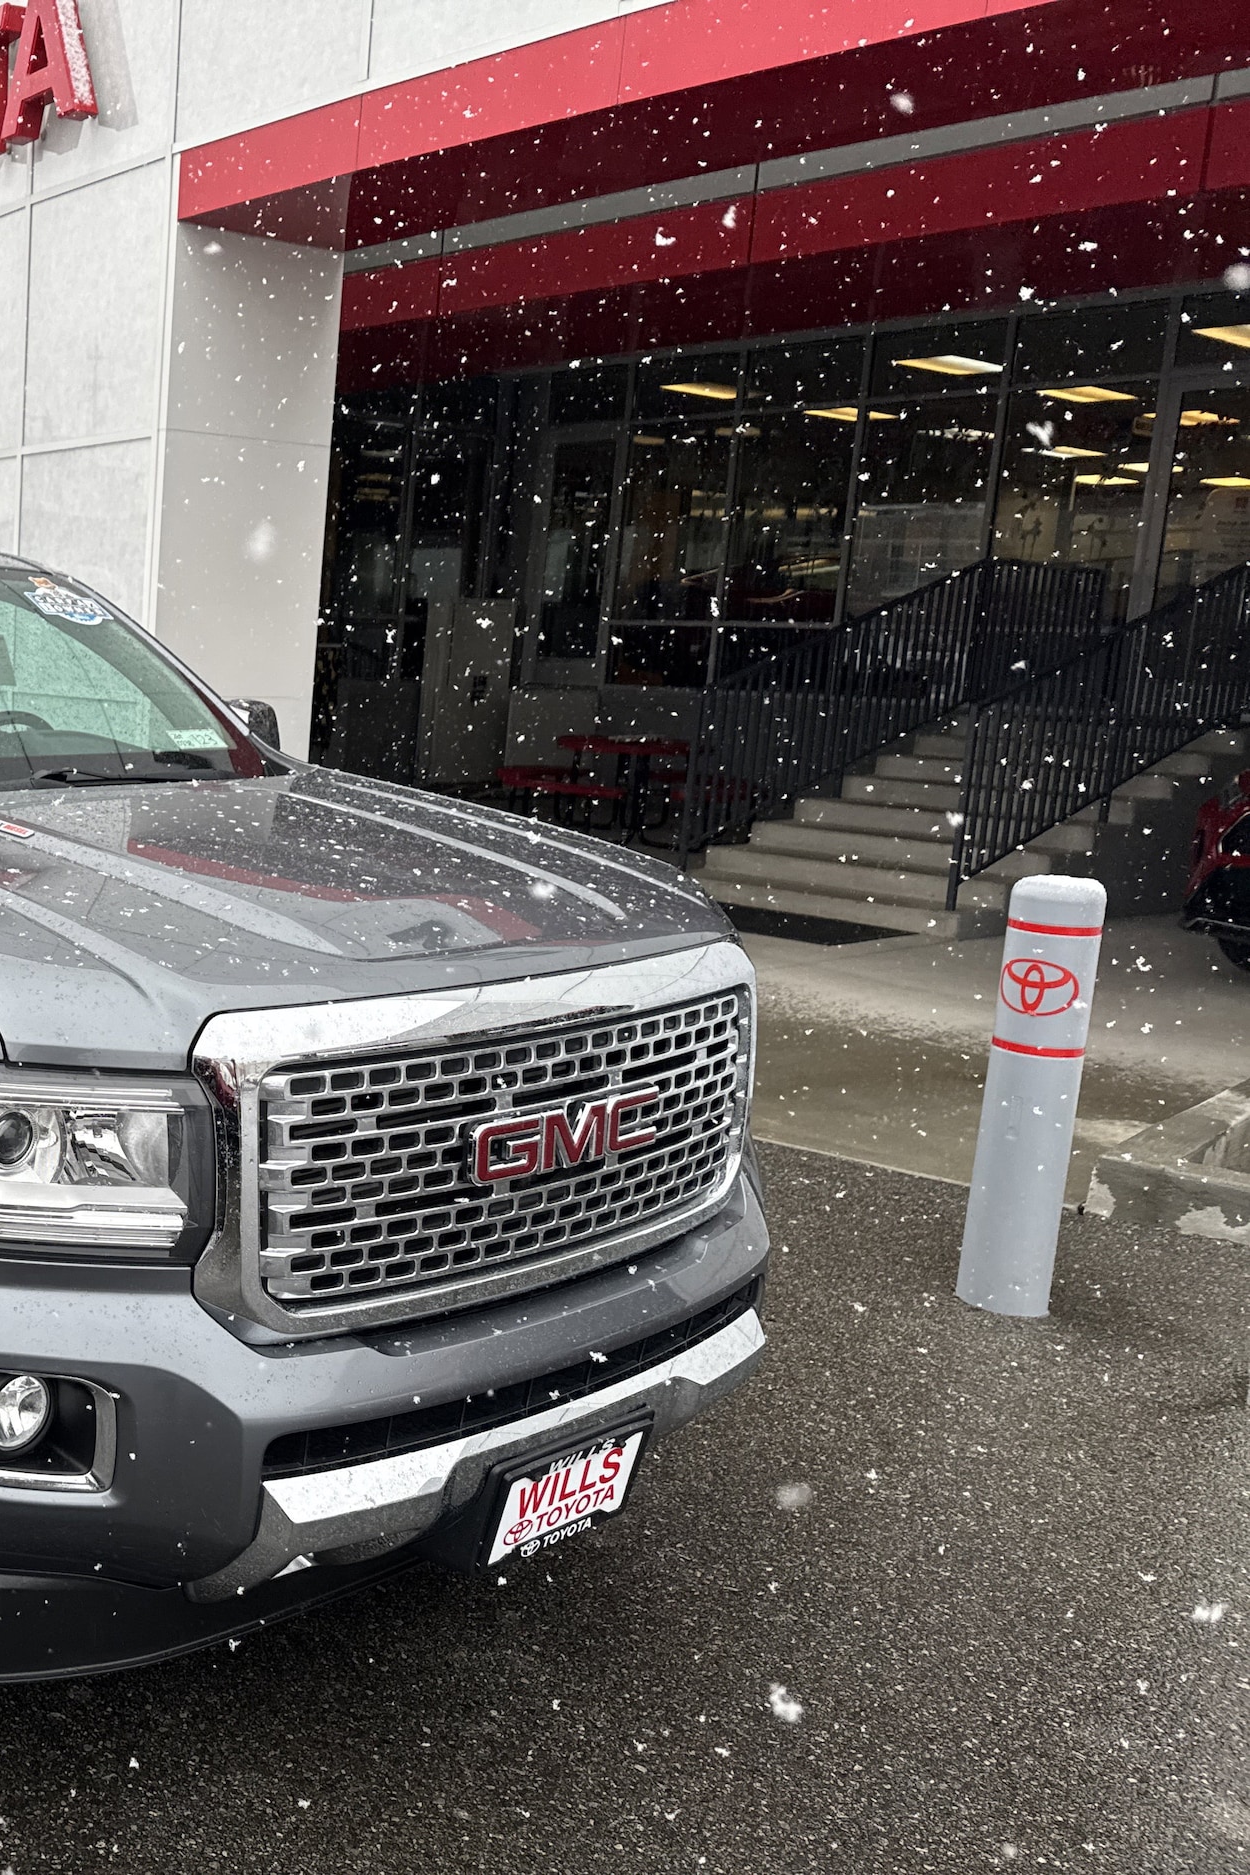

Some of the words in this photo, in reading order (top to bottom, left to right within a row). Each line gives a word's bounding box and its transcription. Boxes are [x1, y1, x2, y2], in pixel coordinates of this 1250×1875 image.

[475, 1085, 660, 1187] GMC
[519, 1447, 623, 1520] WILLS
[535, 1484, 614, 1532] TOYOTA
[543, 1517, 592, 1548] TOYOTA
